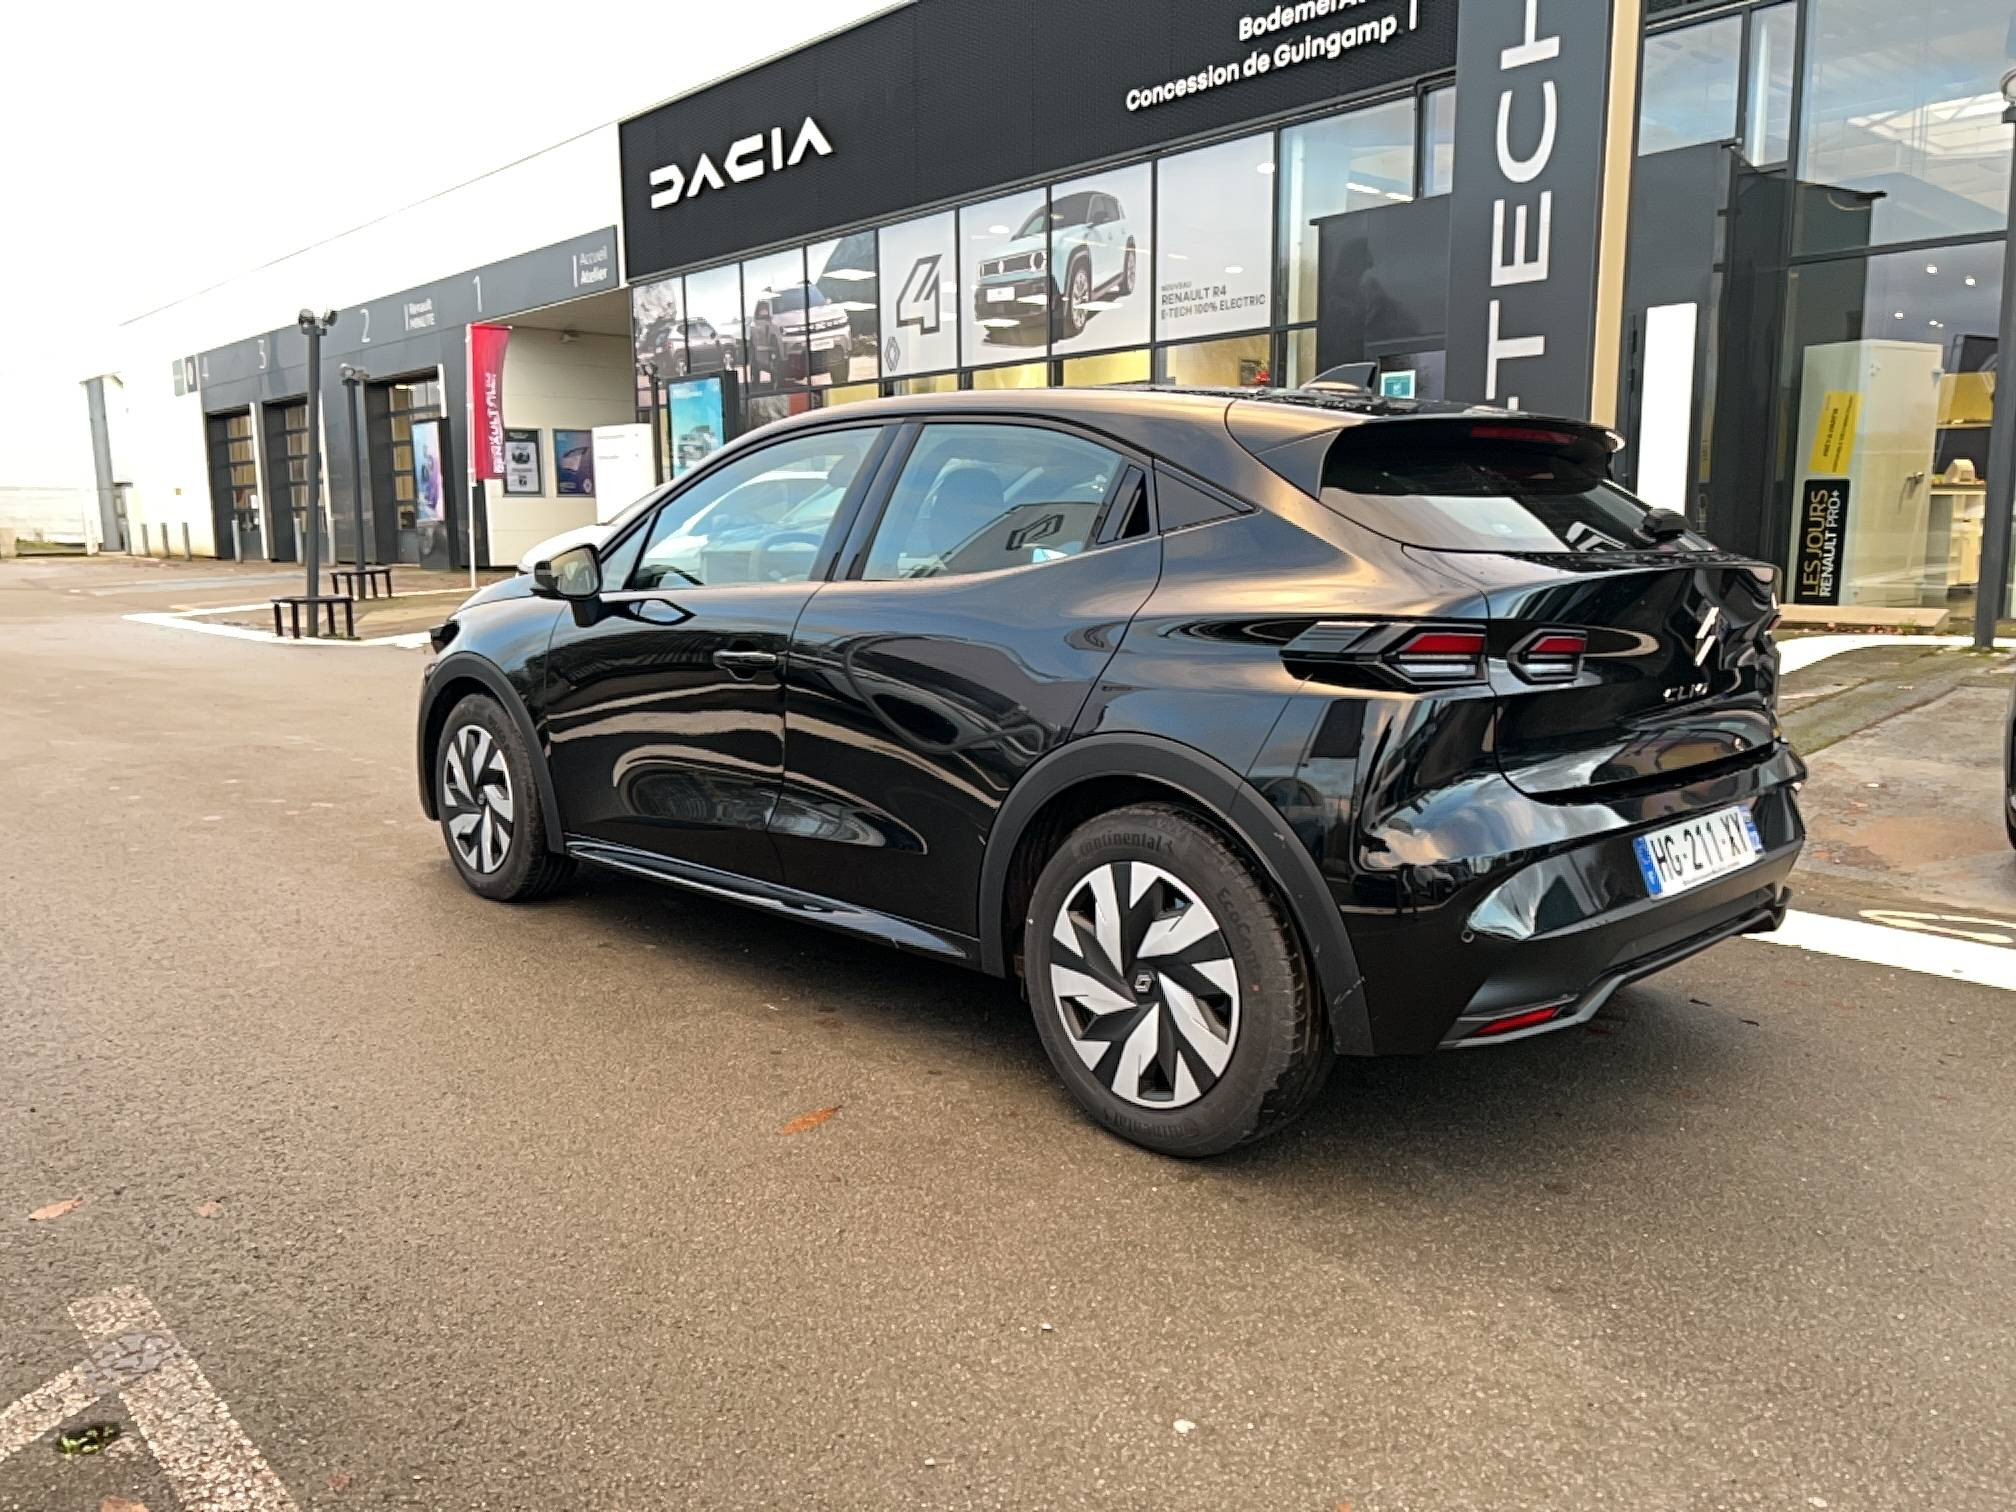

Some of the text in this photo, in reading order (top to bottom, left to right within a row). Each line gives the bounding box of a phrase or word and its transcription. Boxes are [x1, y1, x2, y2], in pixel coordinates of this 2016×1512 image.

[1126, 14, 1397, 111] Concession de Guingamp
[650, 116, 833, 209] DACIA
[360, 308, 370, 343] 2
[472, 275, 482, 312] 1
[896, 253, 942, 336] 4
[1161, 284, 1226, 306] RENAULT R4
[1161, 304, 1193, 320] E-TECH
[1195, 300, 1218, 315] 100%
[1802, 489, 1828, 596] LES JOURS
[1819, 489, 1840, 597] RENAULT PRO+
